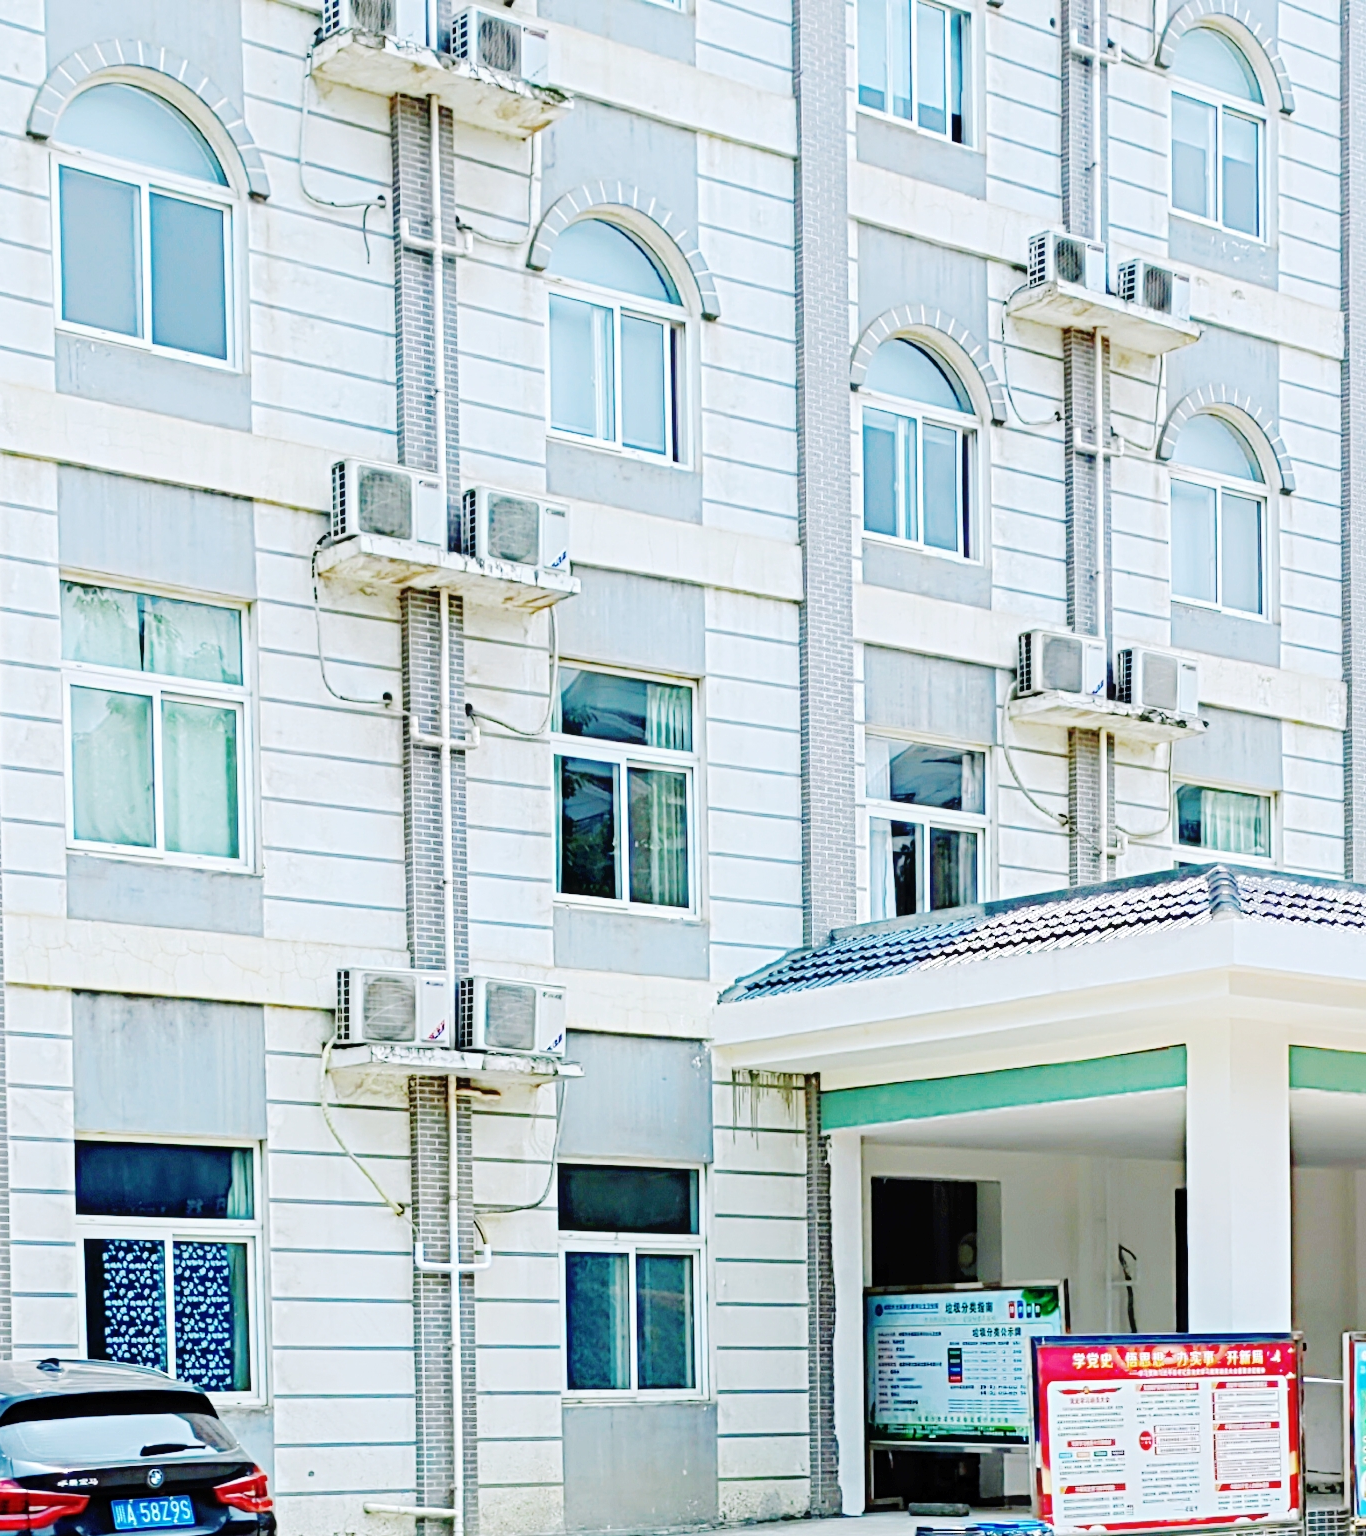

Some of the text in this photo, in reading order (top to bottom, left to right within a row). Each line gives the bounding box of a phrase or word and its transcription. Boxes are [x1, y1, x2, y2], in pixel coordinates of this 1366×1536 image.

[945, 1302, 993, 1314] 垃圾分类指南
[1072, 1349, 1264, 1370] 学党史 悟思想 办实事 开新局
